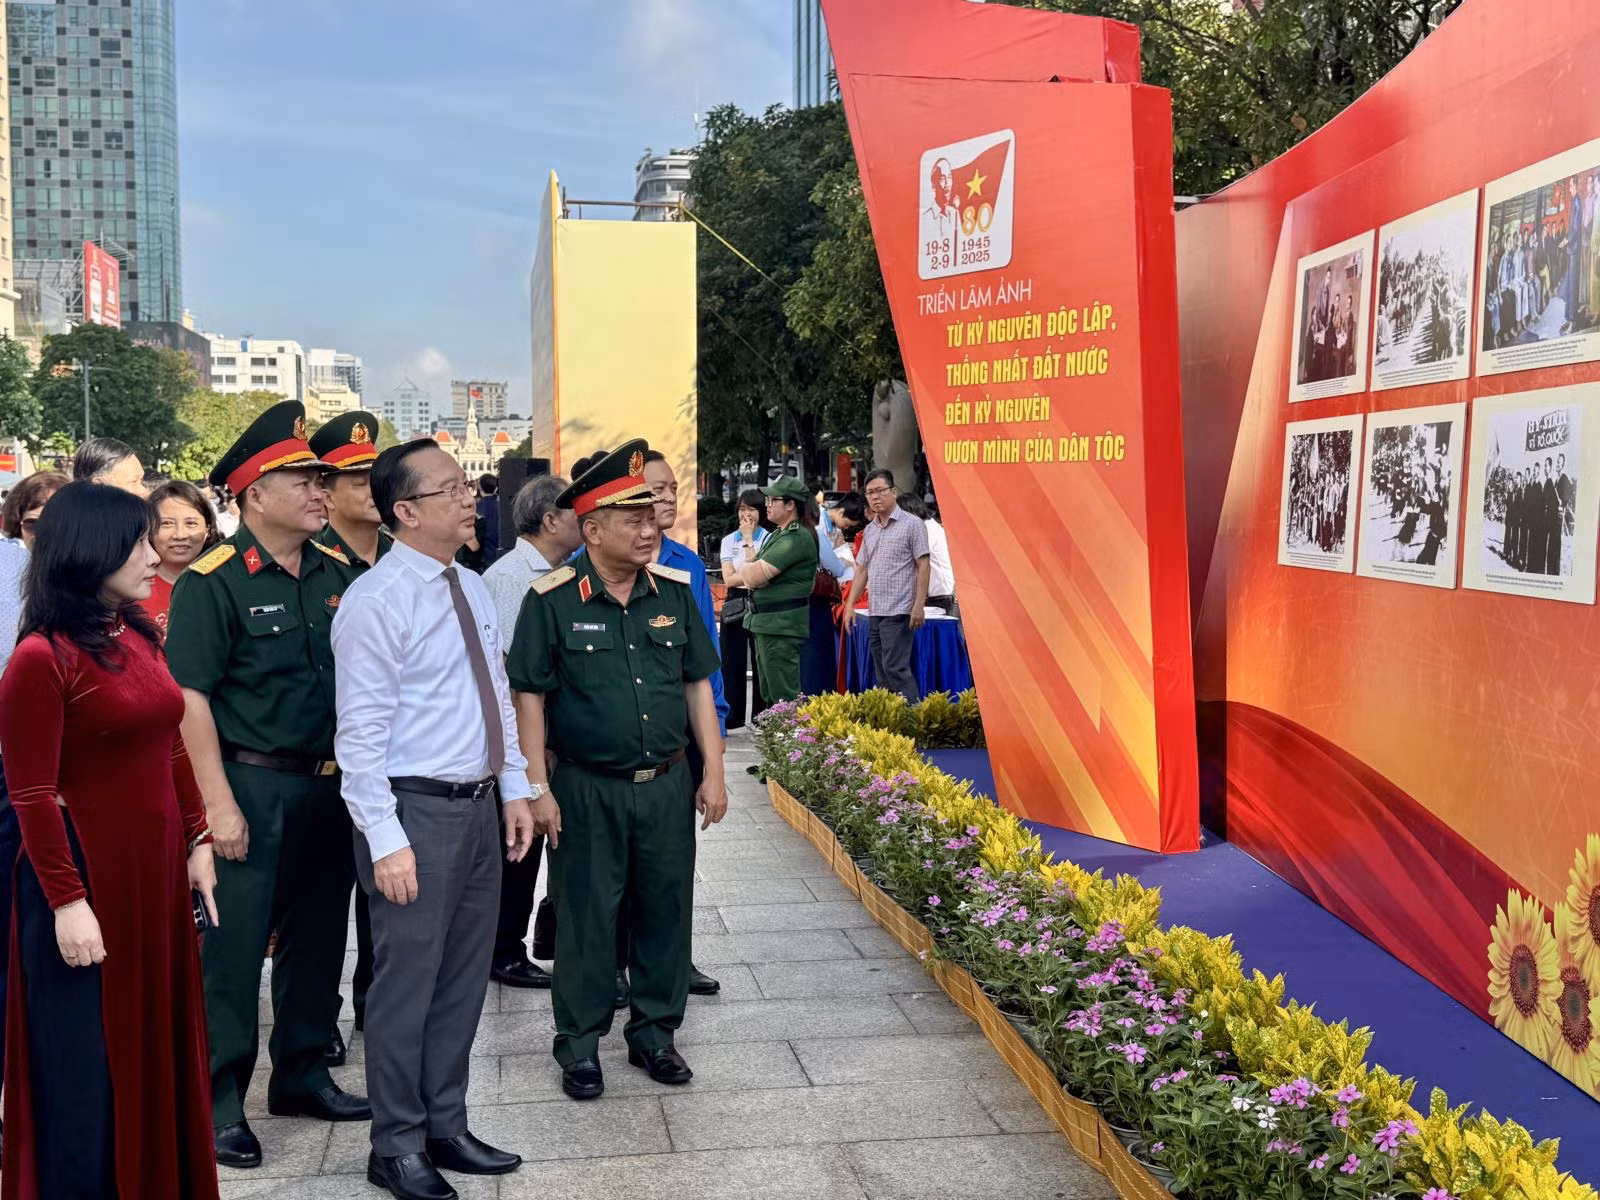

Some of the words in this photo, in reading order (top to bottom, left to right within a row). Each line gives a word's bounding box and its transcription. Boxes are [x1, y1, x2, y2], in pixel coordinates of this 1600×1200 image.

[962, 202, 993, 236] 80
[961, 235, 991, 252] 1945
[961, 249, 991, 265] 2025
[917, 283, 956, 316] TRIỂN
[960, 284, 992, 311] LÃM
[995, 276, 1032, 306] ẢNH
[947, 319, 964, 348] TỪ
[967, 314, 984, 346] KỶ
[987, 310, 1042, 344] NGUYÊN
[1046, 305, 1078, 341] ĐỘC
[1082, 300, 1117, 337] LẬP,
[946, 354, 989, 387] THỐNG
[992, 348, 1029, 383] NHẤT
[1033, 345, 1061, 380] ĐẤT
[1065, 344, 1109, 377] NƯỚC
[945, 393, 970, 425] ĐẾN
[974, 394, 992, 425] KỶ
[995, 392, 1051, 423] NGUYÊN
[944, 438, 979, 464] VƯƠN
[982, 435, 1020, 464] MÌNH
[1025, 431, 1054, 463] CỦA
[1058, 431, 1090, 462] DÂN
[1094, 430, 1125, 466] TỘC
